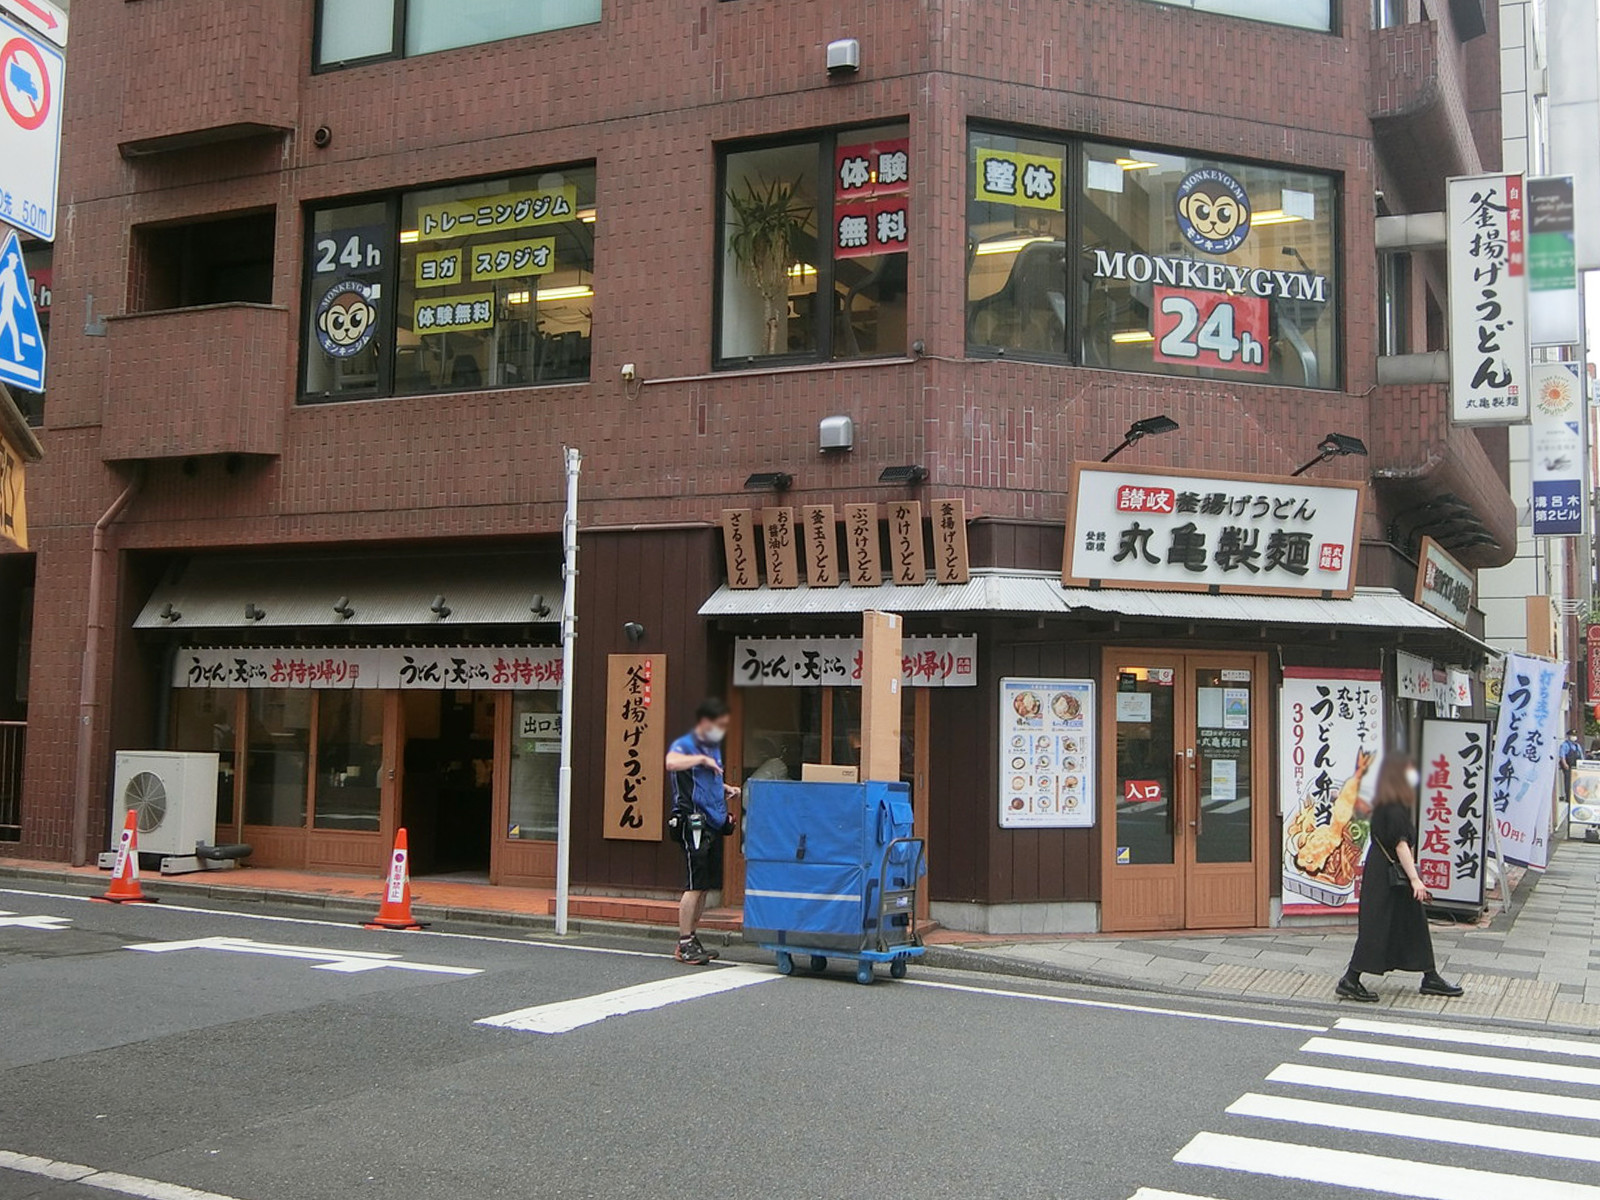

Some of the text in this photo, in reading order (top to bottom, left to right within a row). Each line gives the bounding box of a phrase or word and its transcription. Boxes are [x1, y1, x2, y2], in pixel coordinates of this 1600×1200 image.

[840, 151, 908, 189] 体験
[984, 158, 1056, 199] 整体
[1182, 171, 1244, 199] MONKEYGYM
[22, 200, 47, 231] 50m
[423, 195, 571, 234] トレーニングジム
[839, 210, 907, 247] 無料
[316, 236, 381, 273] 24h
[1186, 227, 1241, 251] モンキージム
[421, 257, 457, 280] ヨガ
[476, 246, 551, 273] スタジオ
[1094, 250, 1326, 302] MONKEYGYM
[1463, 188, 1514, 389] 釜揚げうどん
[417, 301, 491, 328] 体験無料
[1160, 296, 1262, 364] 24h
[1120, 487, 1316, 521] 讃岐 釜揚げうどん
[1535, 509, 1580, 522] 第2ビル
[778, 511, 789, 547] おろし
[811, 510, 829, 581] 釜玉うどん
[852, 508, 872, 582] ぶっかけうどん
[896, 505, 915, 581] かけうどん
[940, 503, 959, 580] 釜揚げうどん
[1113, 521, 1313, 576] 丸亀製麺
[769, 524, 783, 585] 醤油うどん
[491, 657, 563, 686] お持ち帰
[1337, 686, 1354, 719] 丸亀
[1356, 686, 1370, 744] 打ち立て
[619, 665, 649, 829] 釜揚げうどん
[1310, 685, 1339, 828] うどん弁当
[1493, 674, 1531, 812] うどん弁当
[1522, 729, 1543, 763] 丸亀
[1126, 783, 1160, 799] 入口
[1421, 753, 1453, 855] 直売店
[1454, 731, 1483, 880] うどん弁当
